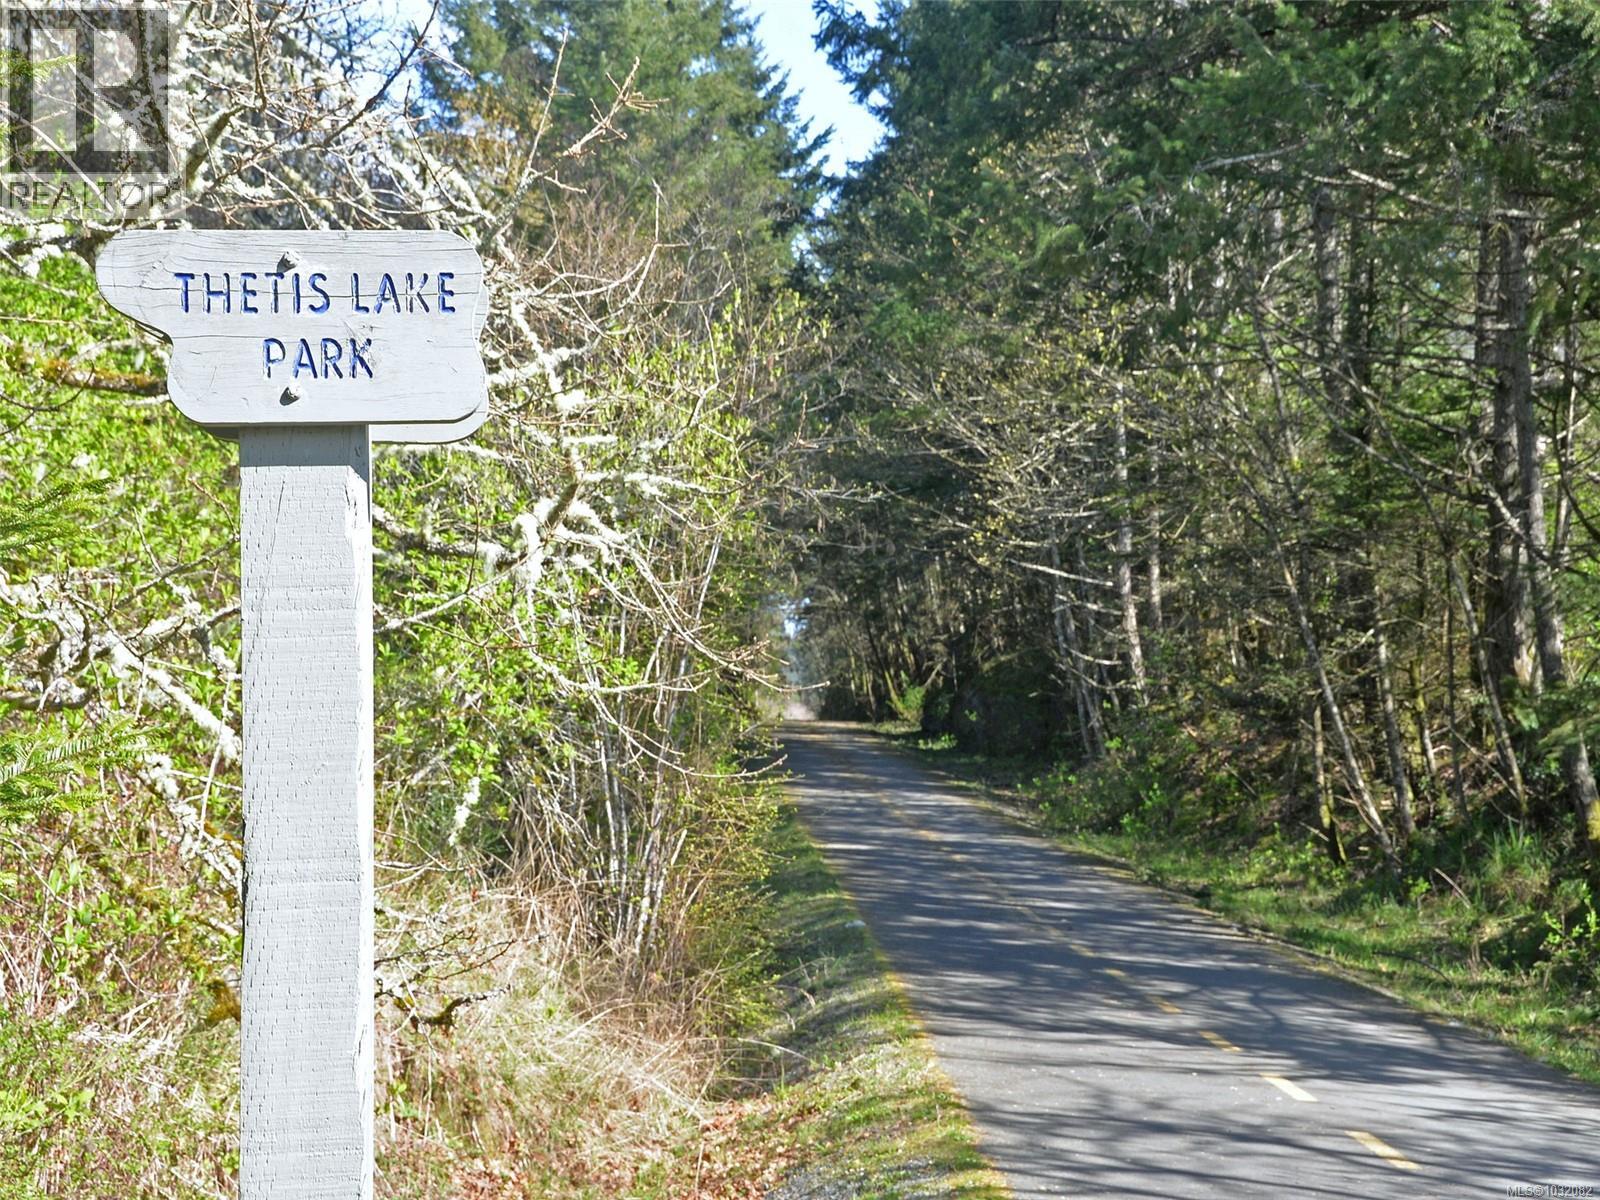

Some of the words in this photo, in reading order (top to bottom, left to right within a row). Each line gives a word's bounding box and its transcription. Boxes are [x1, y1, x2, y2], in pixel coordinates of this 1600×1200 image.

[174, 272, 332, 315] THETIS
[350, 271, 456, 314] LAKE
[262, 337, 374, 380] PARK
